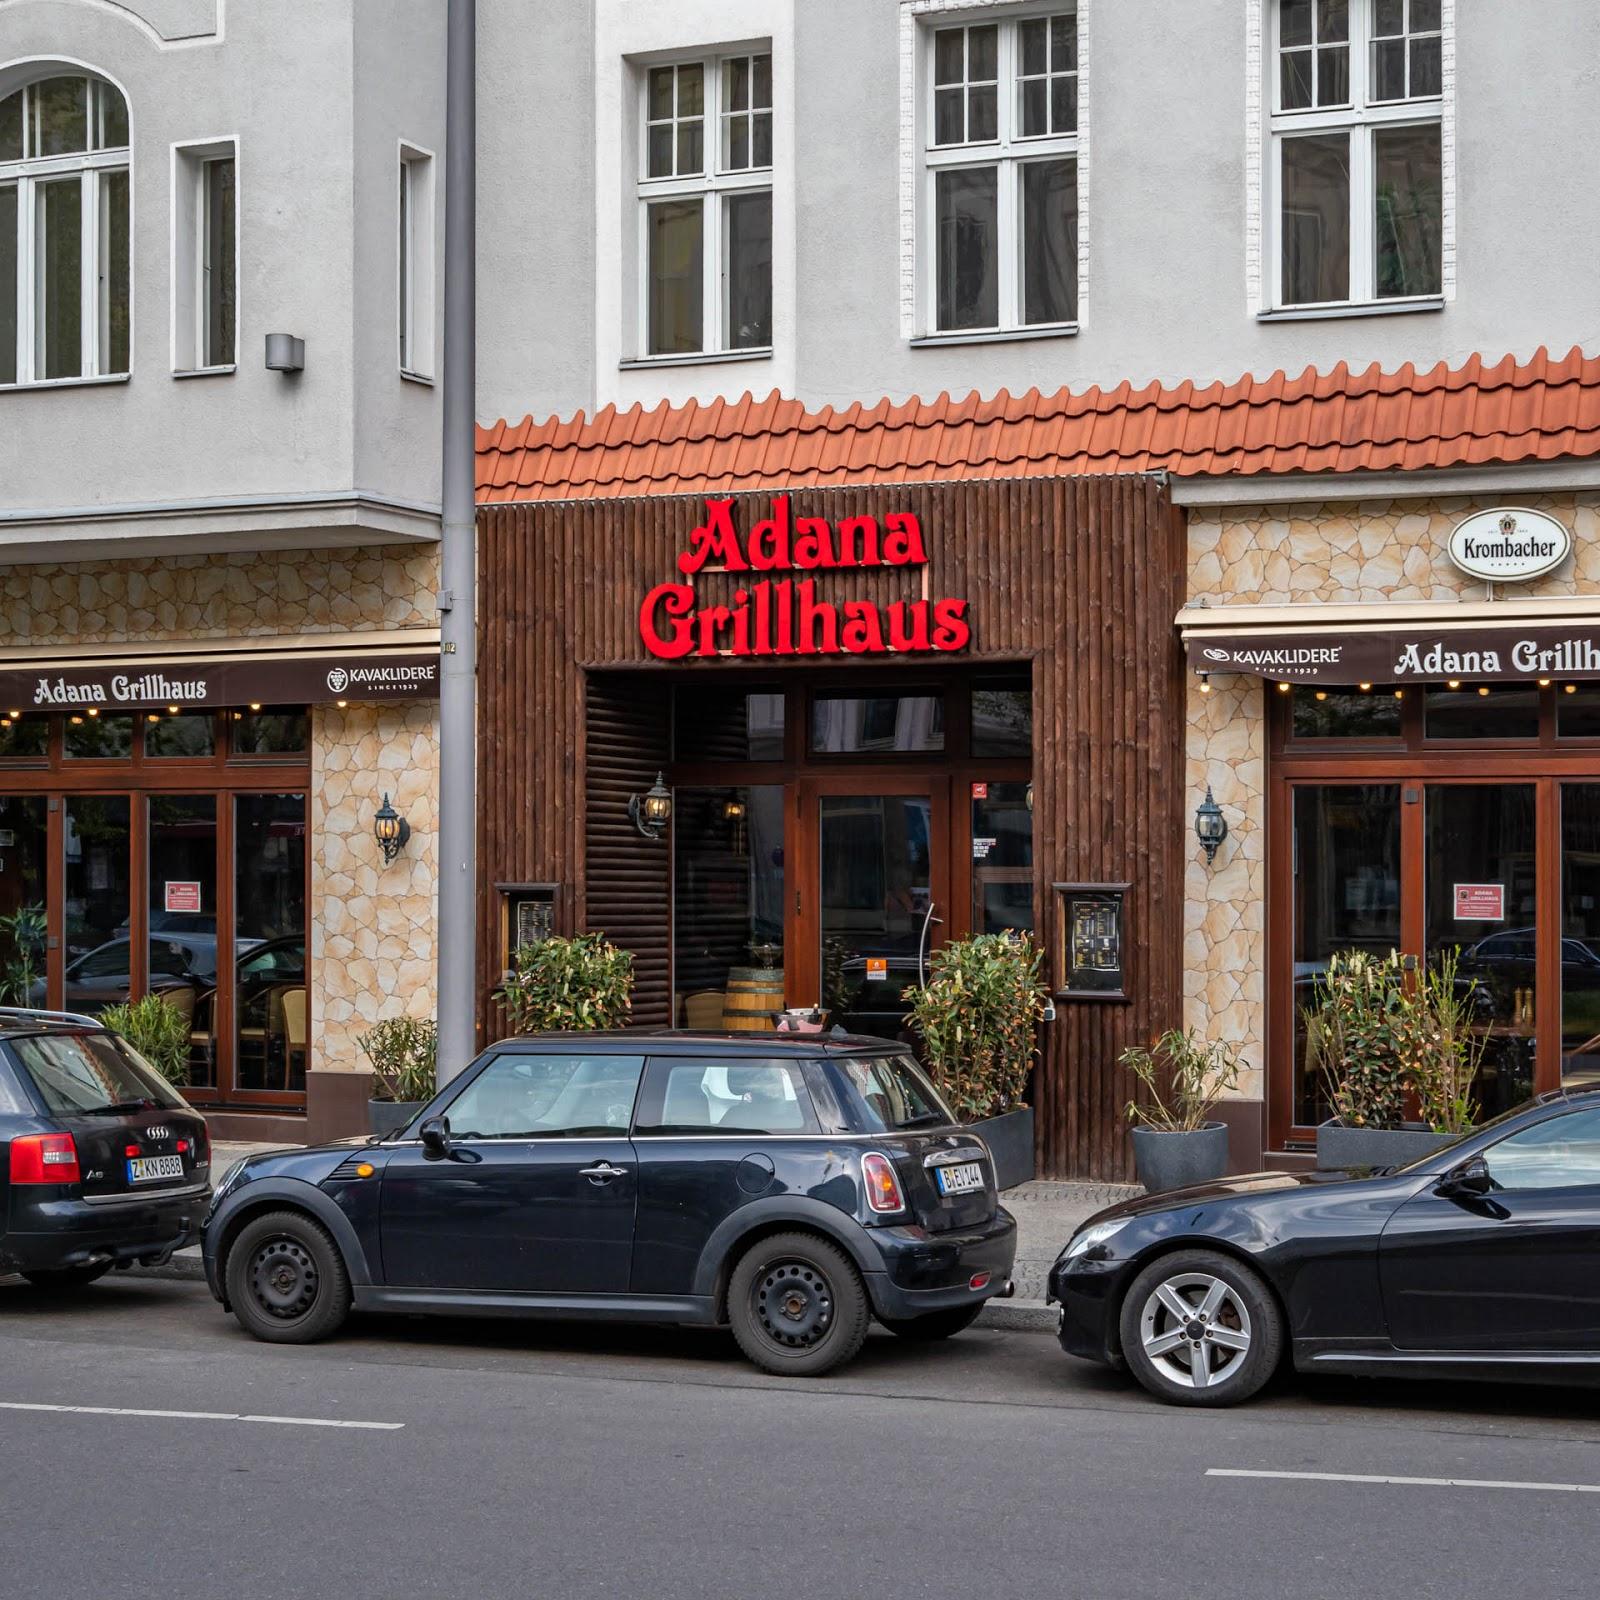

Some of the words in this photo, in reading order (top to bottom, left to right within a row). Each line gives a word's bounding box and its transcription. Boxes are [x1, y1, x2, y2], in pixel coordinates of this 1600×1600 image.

[678, 493, 929, 574] Adana
[1464, 536, 1556, 559] Krombacher
[639, 577, 970, 659] Grillhaus
[1233, 648, 1340, 664] KAVAKLIDERE
[1394, 642, 1502, 675] Adana
[350, 666, 435, 682] KAVAKLIDERE
[33, 677, 107, 704] Adana
[111, 674, 207, 701] Grillhaus
[131, 1161, 140, 1178] Z
[144, 1160, 159, 1177] KN
[159, 1157, 181, 1176] 8888
[943, 1170, 952, 1189] B
